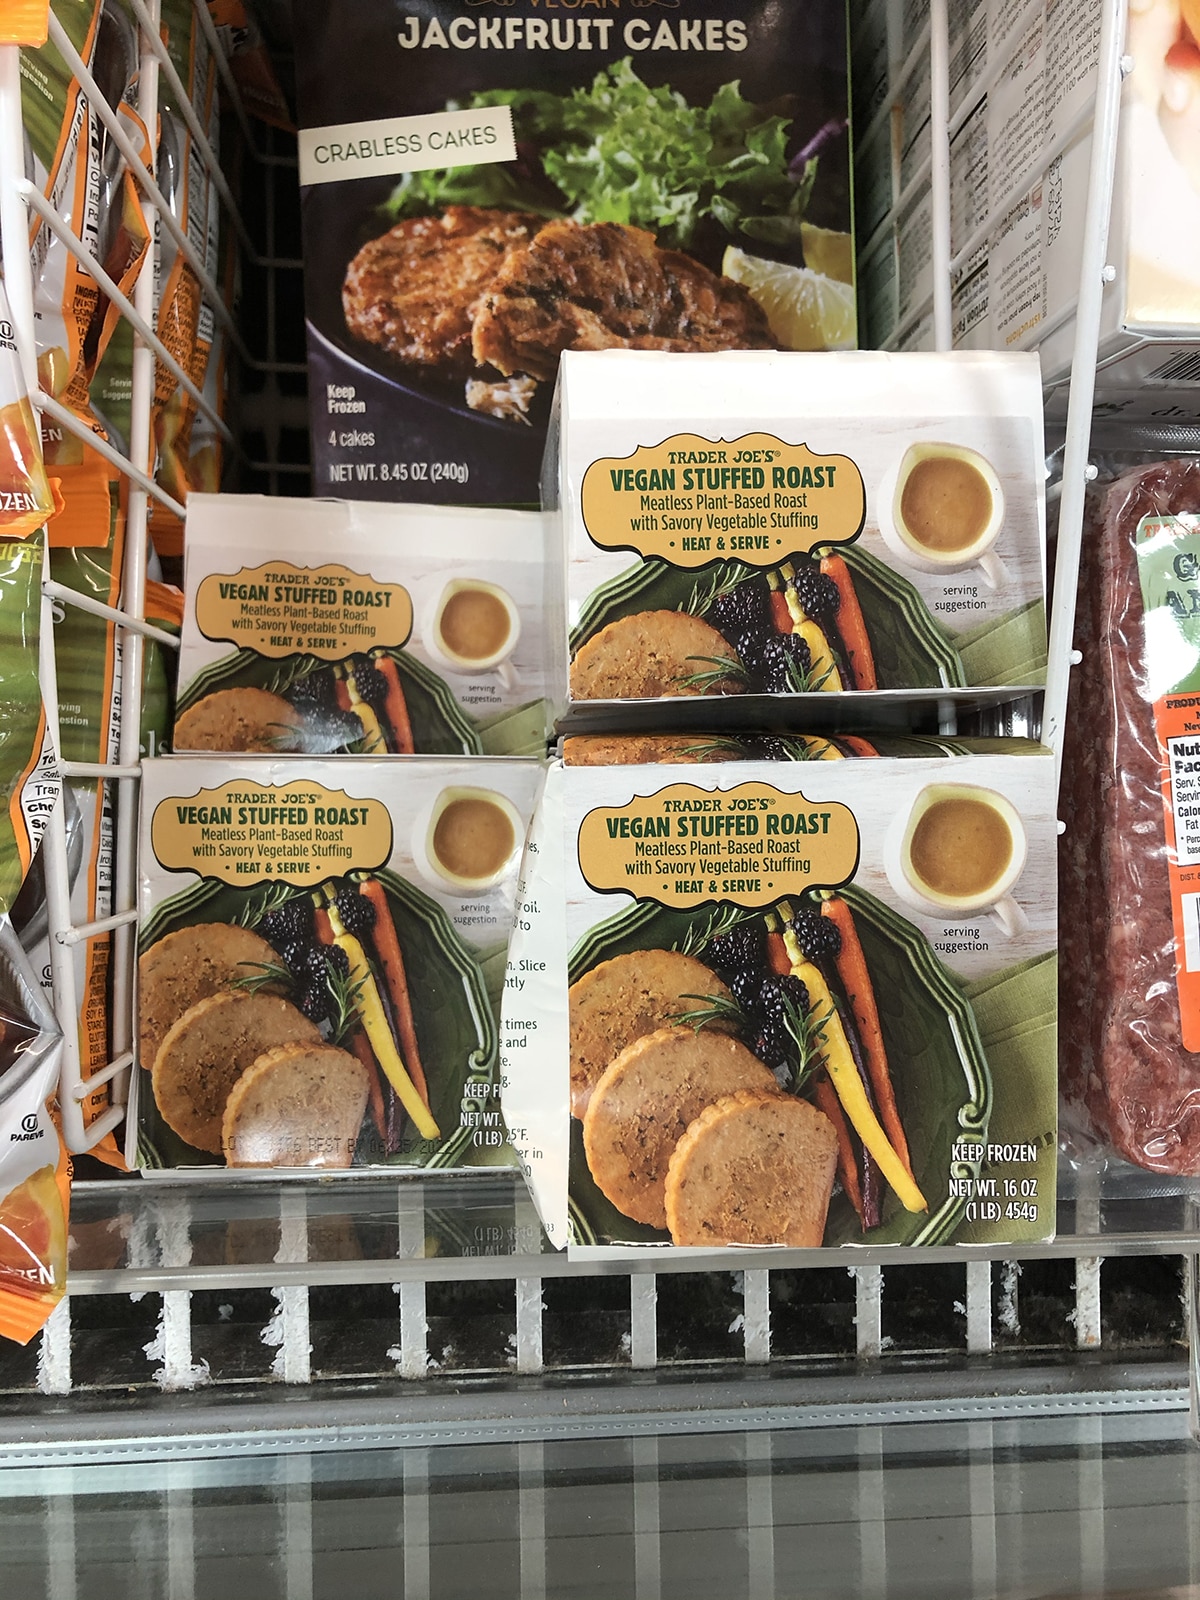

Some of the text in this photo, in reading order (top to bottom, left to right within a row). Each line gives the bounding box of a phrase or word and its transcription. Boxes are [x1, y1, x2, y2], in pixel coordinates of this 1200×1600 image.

[397, 16, 749, 52] JACKFRUIT CAKES
[314, 126, 498, 165] CRABLESS CAKES
[327, 384, 356, 399] Keep
[327, 400, 366, 414] Frozen
[329, 430, 376, 447] 4 cakes
[668, 451, 728, 465] TRADER
[330, 462, 469, 484] NET WT. 8.45 OZ (240g)
[610, 466, 837, 491] VEGAN STUFFED ROAST
[640, 493, 808, 512] Meatless Plant-Based Roast
[630, 512, 819, 533] with Savory Vegetable Stuffing
[682, 536, 770, 551] HEAT & SERVE
[264, 572, 310, 585] TRADER
[219, 582, 392, 608] VEGAN STUFFED ROAST
[943, 585, 978, 598] serving
[240, 603, 369, 621] Meatless Plant-Based Roast
[934, 599, 987, 613] suggestion
[232, 618, 377, 638] with Savory Vegetable Stuffing
[270, 636, 338, 649] HEAT & SERVE
[468, 685, 496, 695] serving
[461, 695, 503, 705] suggestion
[1175, 777, 1196, 790] Serv.
[226, 793, 277, 805] TRADER
[663, 799, 723, 813] TRADER
[176, 806, 369, 826] VEGAN STUFFED ROAST
[606, 813, 831, 839] VEGAN STUFFED ROAST
[201, 827, 344, 842] Meatless Plant-Based Roast
[192, 843, 353, 859] with Savory Vegetable Stuffing
[635, 838, 801, 857] Meatless Plant-Based Roast
[236, 862, 311, 874] HEAT & SERVE
[625, 856, 811, 877] with Savory Vegetable Stuffing
[675, 879, 762, 894] HEAT & SERVE
[460, 903, 491, 914] serving
[523, 901, 541, 914] oil.
[453, 915, 497, 927] suggestion
[519, 919, 531, 931] to
[943, 926, 980, 940] serving
[934, 940, 989, 954] suggestion
[519, 959, 546, 972] Slice
[505, 1018, 538, 1030] times
[505, 1035, 527, 1048] and
[463, 1083, 489, 1099] KEEP
[460, 1112, 502, 1127] NET WT.
[10, 1129, 45, 1142] PAREVE
[486, 1131, 503, 1148] LB)
[532, 1147, 544, 1159] in
[951, 1144, 1038, 1162] KEEP FROZEN
[948, 1179, 1038, 1197] NET WT. 16 OZ
[965, 1202, 1038, 1222] (1 LB) 454g
